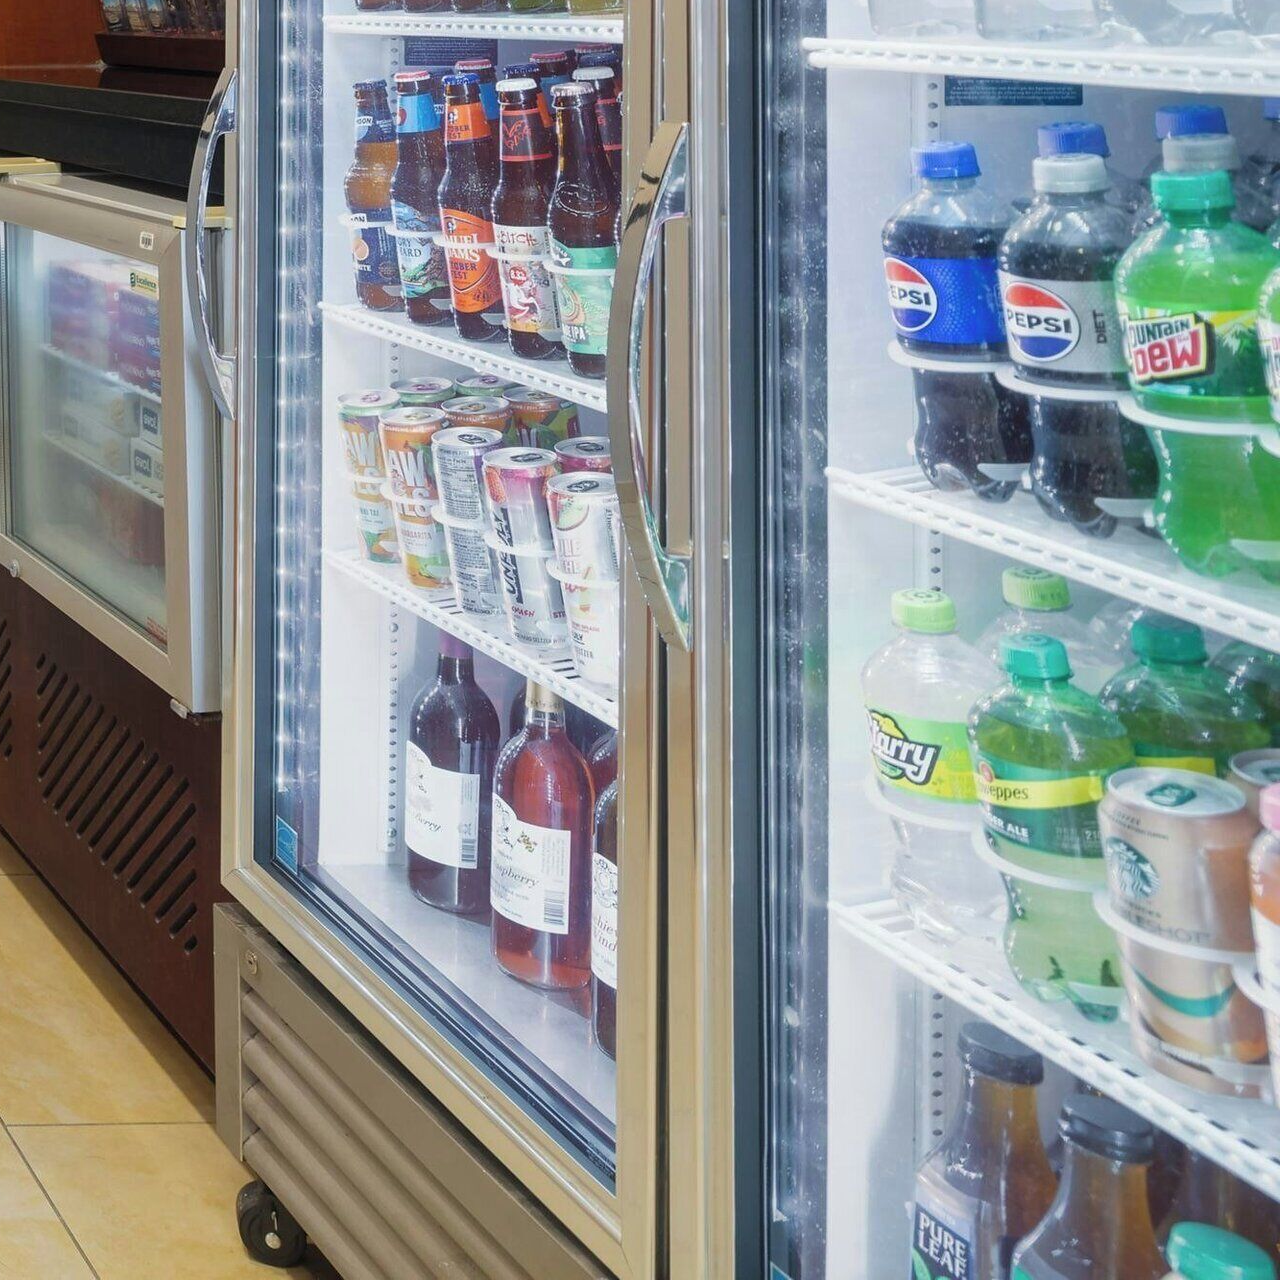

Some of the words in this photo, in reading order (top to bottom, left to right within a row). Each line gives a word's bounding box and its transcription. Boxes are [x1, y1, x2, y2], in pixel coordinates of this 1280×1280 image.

[1007, 308, 1072, 334] PEPSI
[1093, 309, 1107, 344] DIET
[1007, 823, 1029, 838] ALE
[919, 1211, 966, 1259] PURE
[919, 1230, 967, 1278] LEAF
